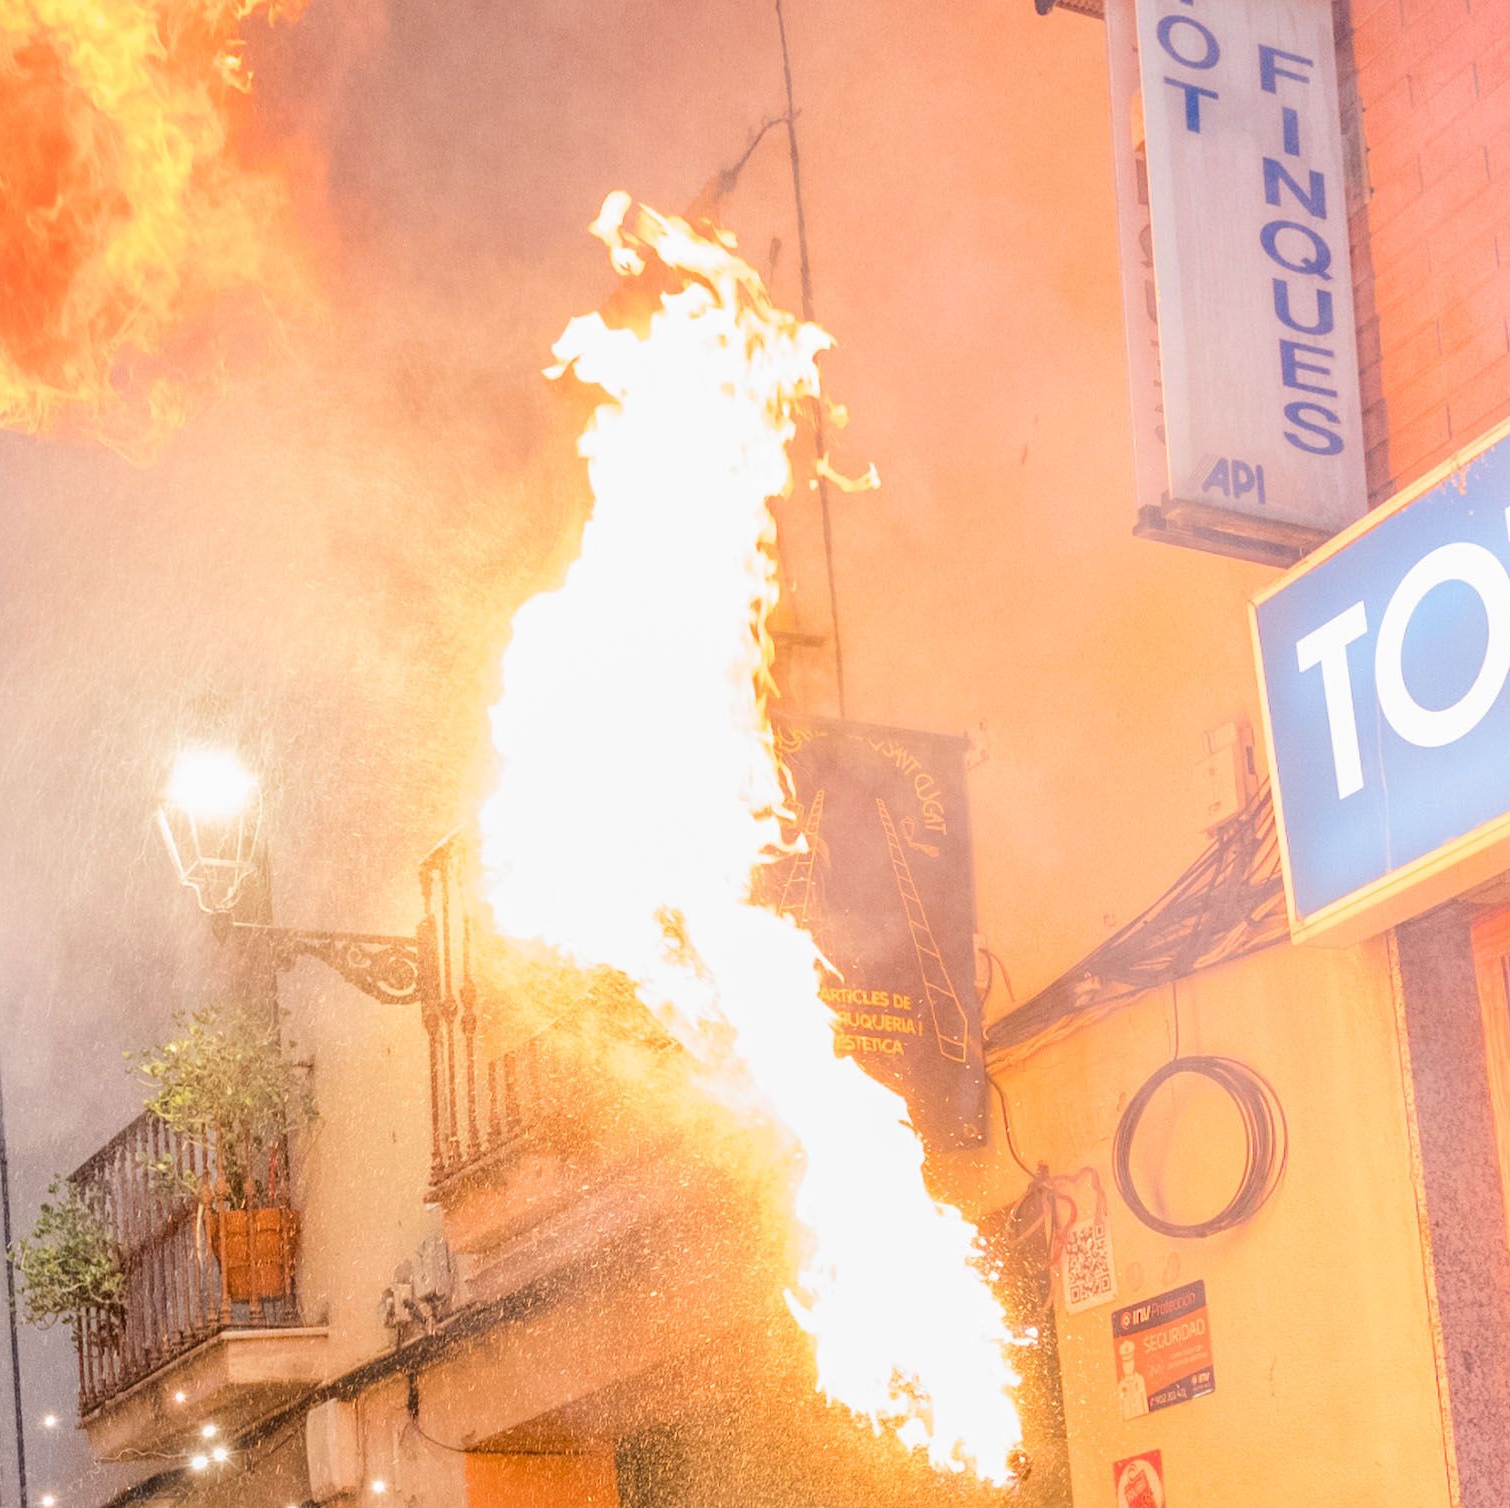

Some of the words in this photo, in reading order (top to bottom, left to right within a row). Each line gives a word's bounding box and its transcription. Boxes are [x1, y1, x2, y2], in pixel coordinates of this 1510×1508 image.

[1156, 0, 1221, 134] OT
[1258, 44, 1344, 457] FINQUES
[1200, 458, 1266, 505] API
[893, 993, 911, 1010] DE
[1143, 1318, 1206, 1354] SEGURIDAD
